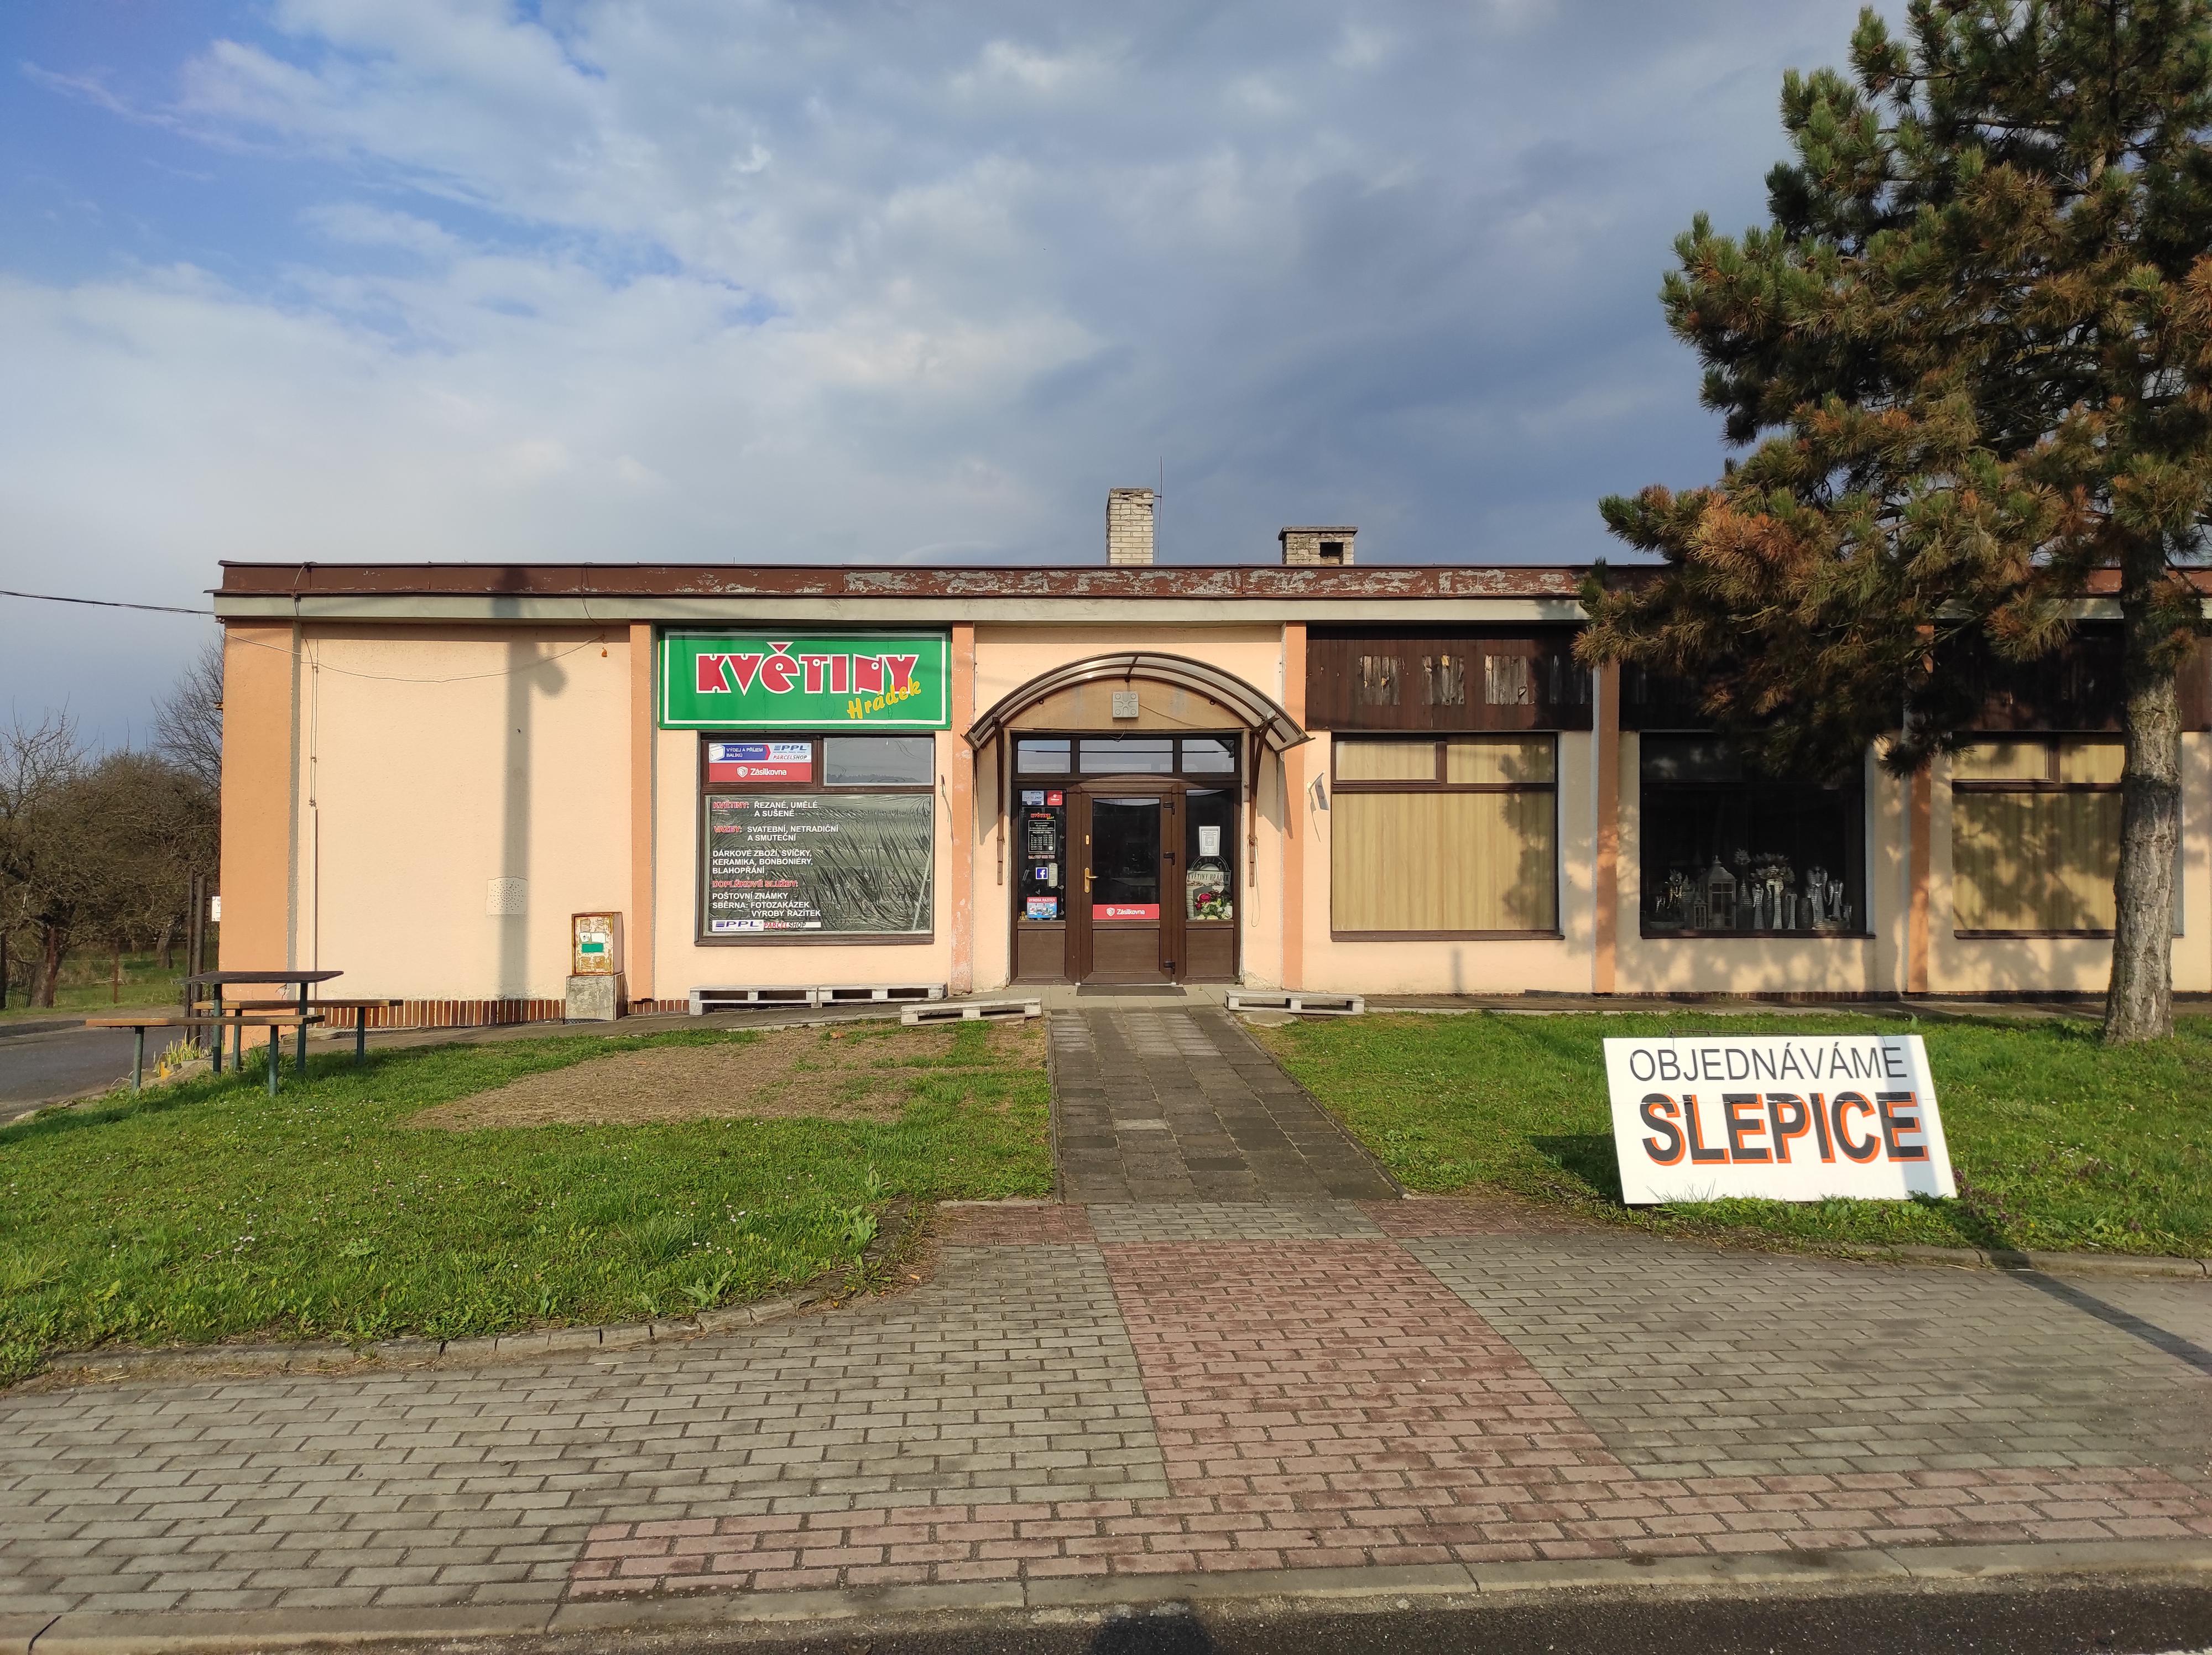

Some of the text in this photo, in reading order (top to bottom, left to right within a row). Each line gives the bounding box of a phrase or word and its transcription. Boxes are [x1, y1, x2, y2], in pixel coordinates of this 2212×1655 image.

[847, 677, 921, 719] Hrádek
[754, 801, 789, 810] ŘEZANÉ,
[791, 801, 818, 809] UMĚLÉ
[747, 824, 788, 834] SVATEBNÍ,
[712, 849, 752, 857] DÁRKOVÉ
[781, 849, 812, 858] SVÍČKY,
[712, 866, 765, 874] BLAHOPŘÁNÍ
[712, 891, 788, 900] POŠTOVNÍ ZNÁMKY
[750, 900, 810, 909] FOTOZAKÁZEK
[1630, 1042, 1908, 1081] OBJEDNÁVÁME
[1640, 1091, 1929, 1166] SLEPICE
